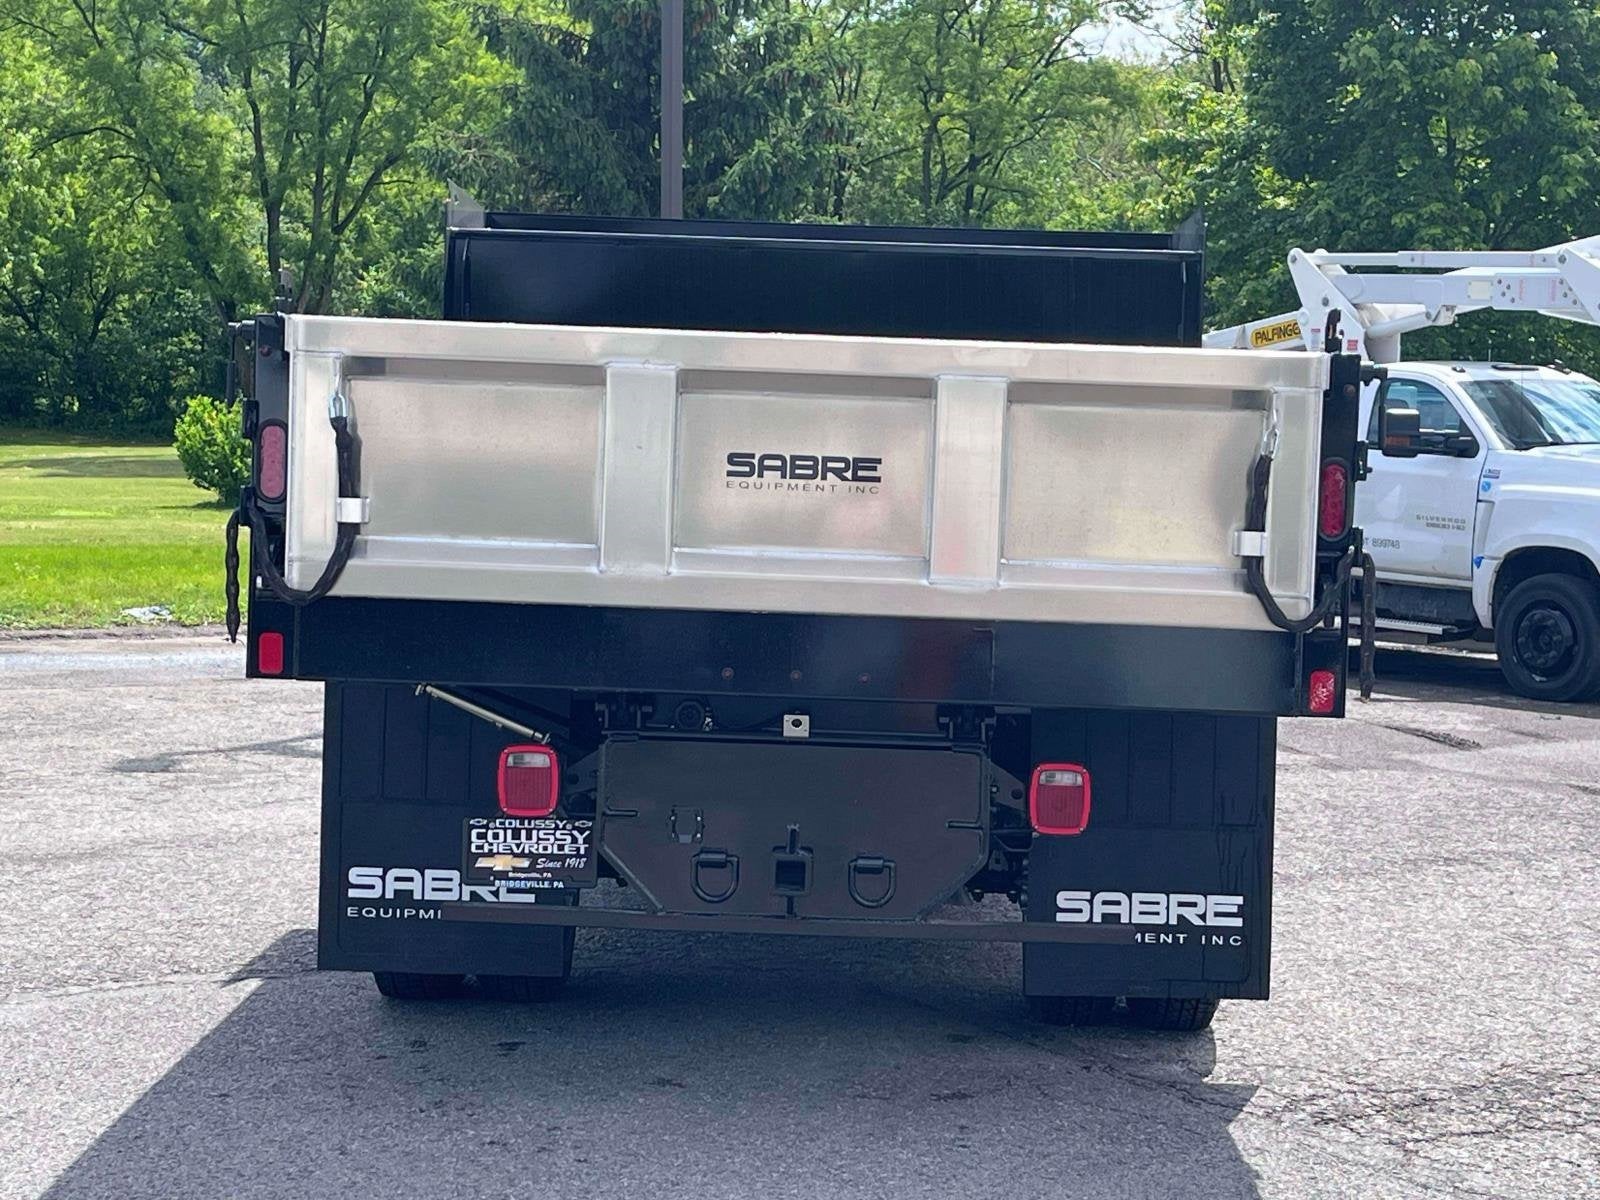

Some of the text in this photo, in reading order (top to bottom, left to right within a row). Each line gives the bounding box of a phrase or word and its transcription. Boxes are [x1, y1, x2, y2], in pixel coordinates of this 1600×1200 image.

[1255, 322, 1301, 345] PALFINGE
[726, 452, 882, 483] SABRE
[726, 480, 880, 495] EQUIPMENT INC
[495, 819, 567, 829] COLUSSY
[470, 828, 591, 845] COLUSSY
[470, 842, 589, 855] CHEVROLET
[536, 857, 587, 869] Since 1918
[553, 880, 565, 889] PA
[1055, 890, 1244, 927] SABRE
[1201, 935, 1242, 946] INC
